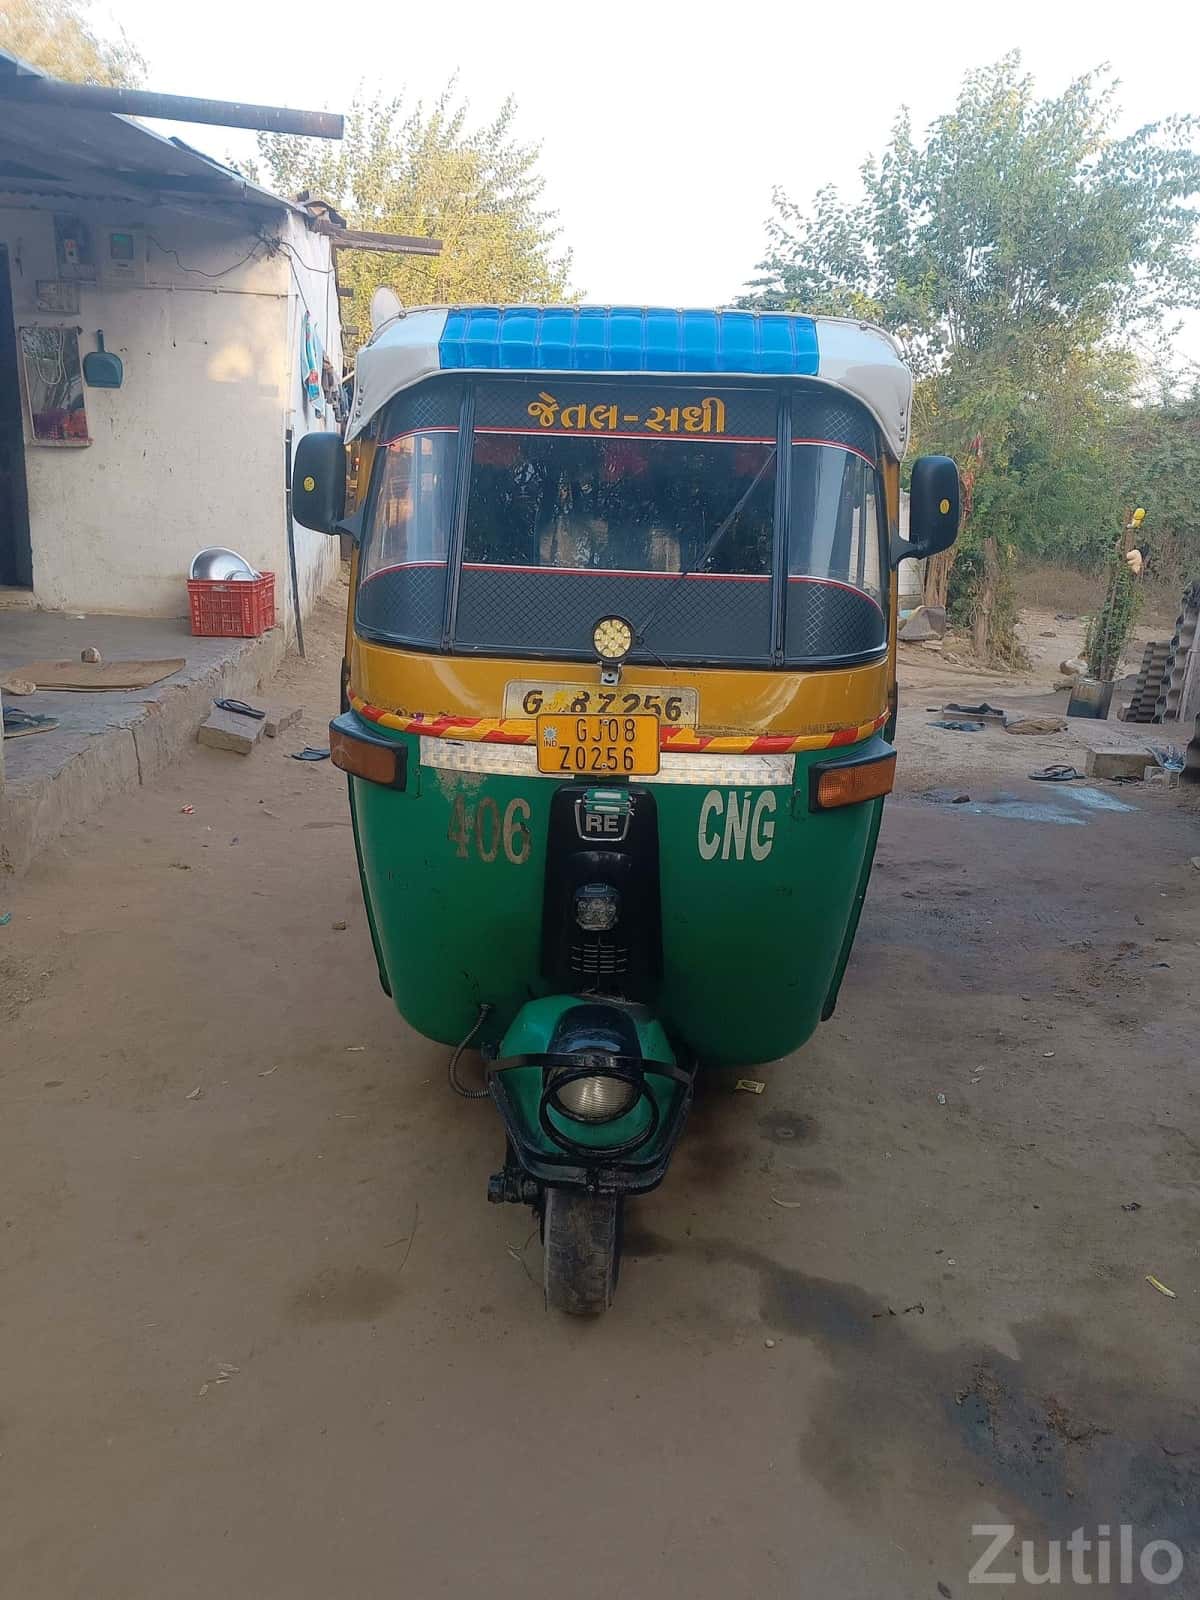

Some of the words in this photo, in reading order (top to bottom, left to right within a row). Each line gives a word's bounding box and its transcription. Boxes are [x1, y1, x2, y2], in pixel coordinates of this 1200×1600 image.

[576, 718, 636, 742] GJ08
[543, 740, 557, 748] IND
[559, 746, 634, 770] Z0256
[448, 794, 532, 864] 406
[585, 814, 619, 833] RE
